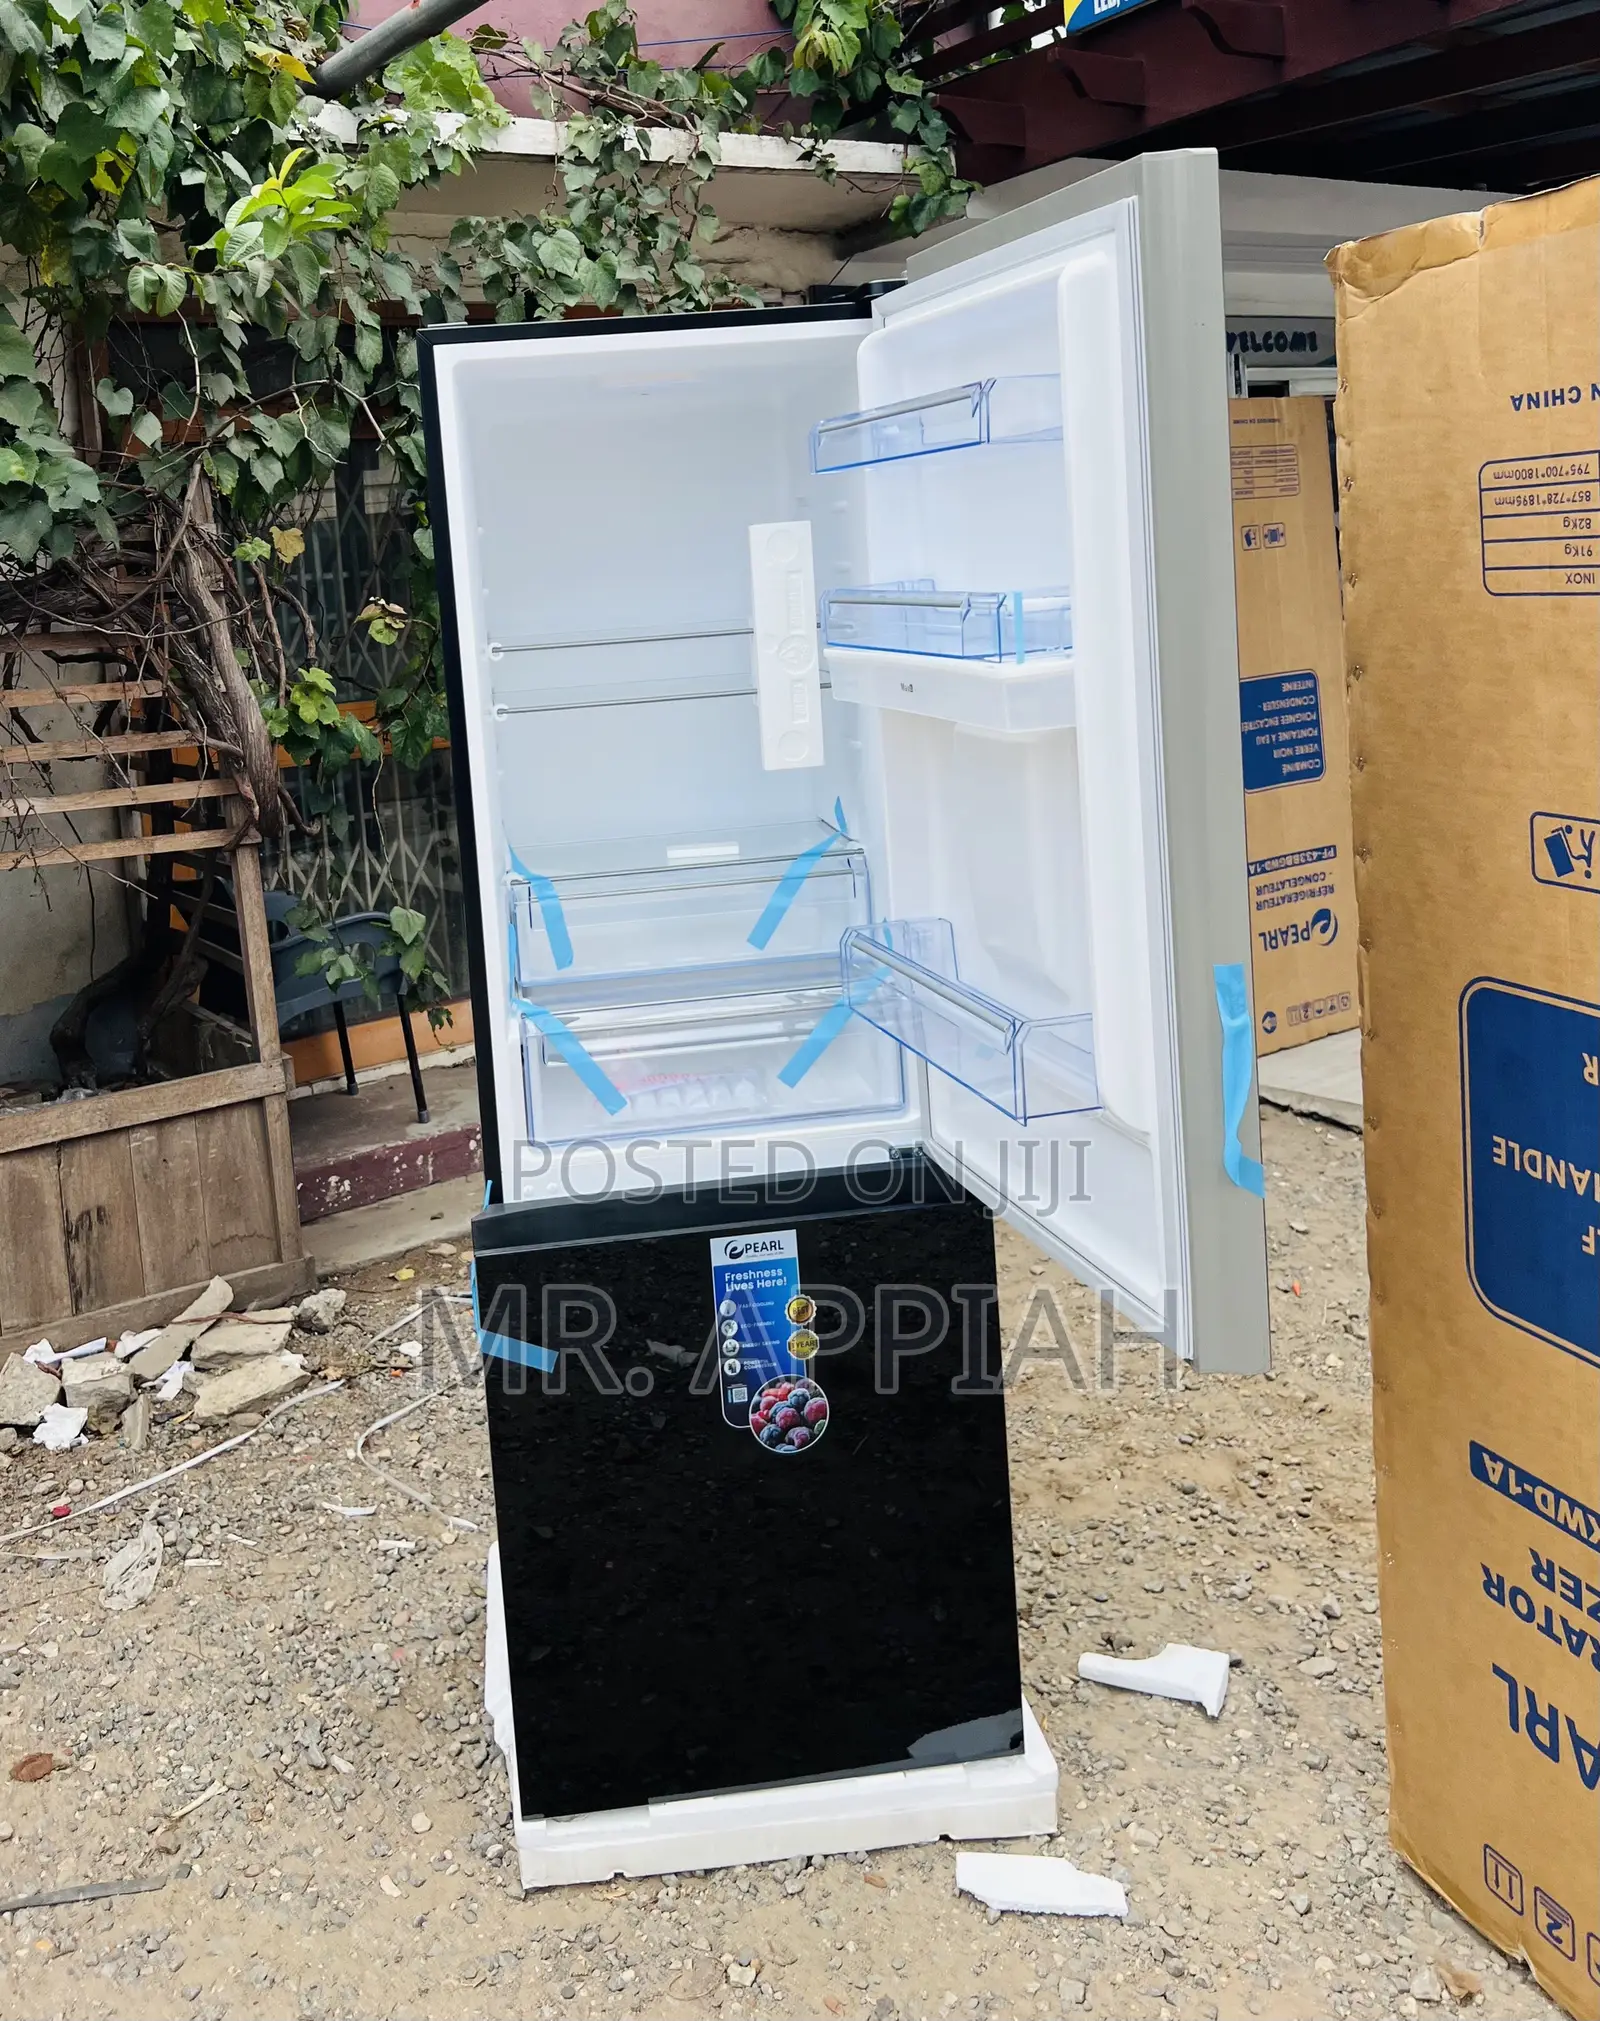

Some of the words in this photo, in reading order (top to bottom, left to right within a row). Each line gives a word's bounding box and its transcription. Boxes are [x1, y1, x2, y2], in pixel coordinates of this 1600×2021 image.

[1510, 386, 1582, 412] CHINA
[1563, 517, 1592, 530] 82Kg
[1564, 543, 1593, 557] 91Kg
[1565, 572, 1596, 585] INOX
[1279, 727, 1318, 742] FONTAINE
[1258, 920, 1311, 951] PEARL
[744, 1239, 785, 1254] PEARL
[1582, 1225, 1600, 1256] F
[725, 1268, 783, 1282] Freshness
[725, 1280, 755, 1292] Lives
[756, 1276, 788, 1288] Here!
